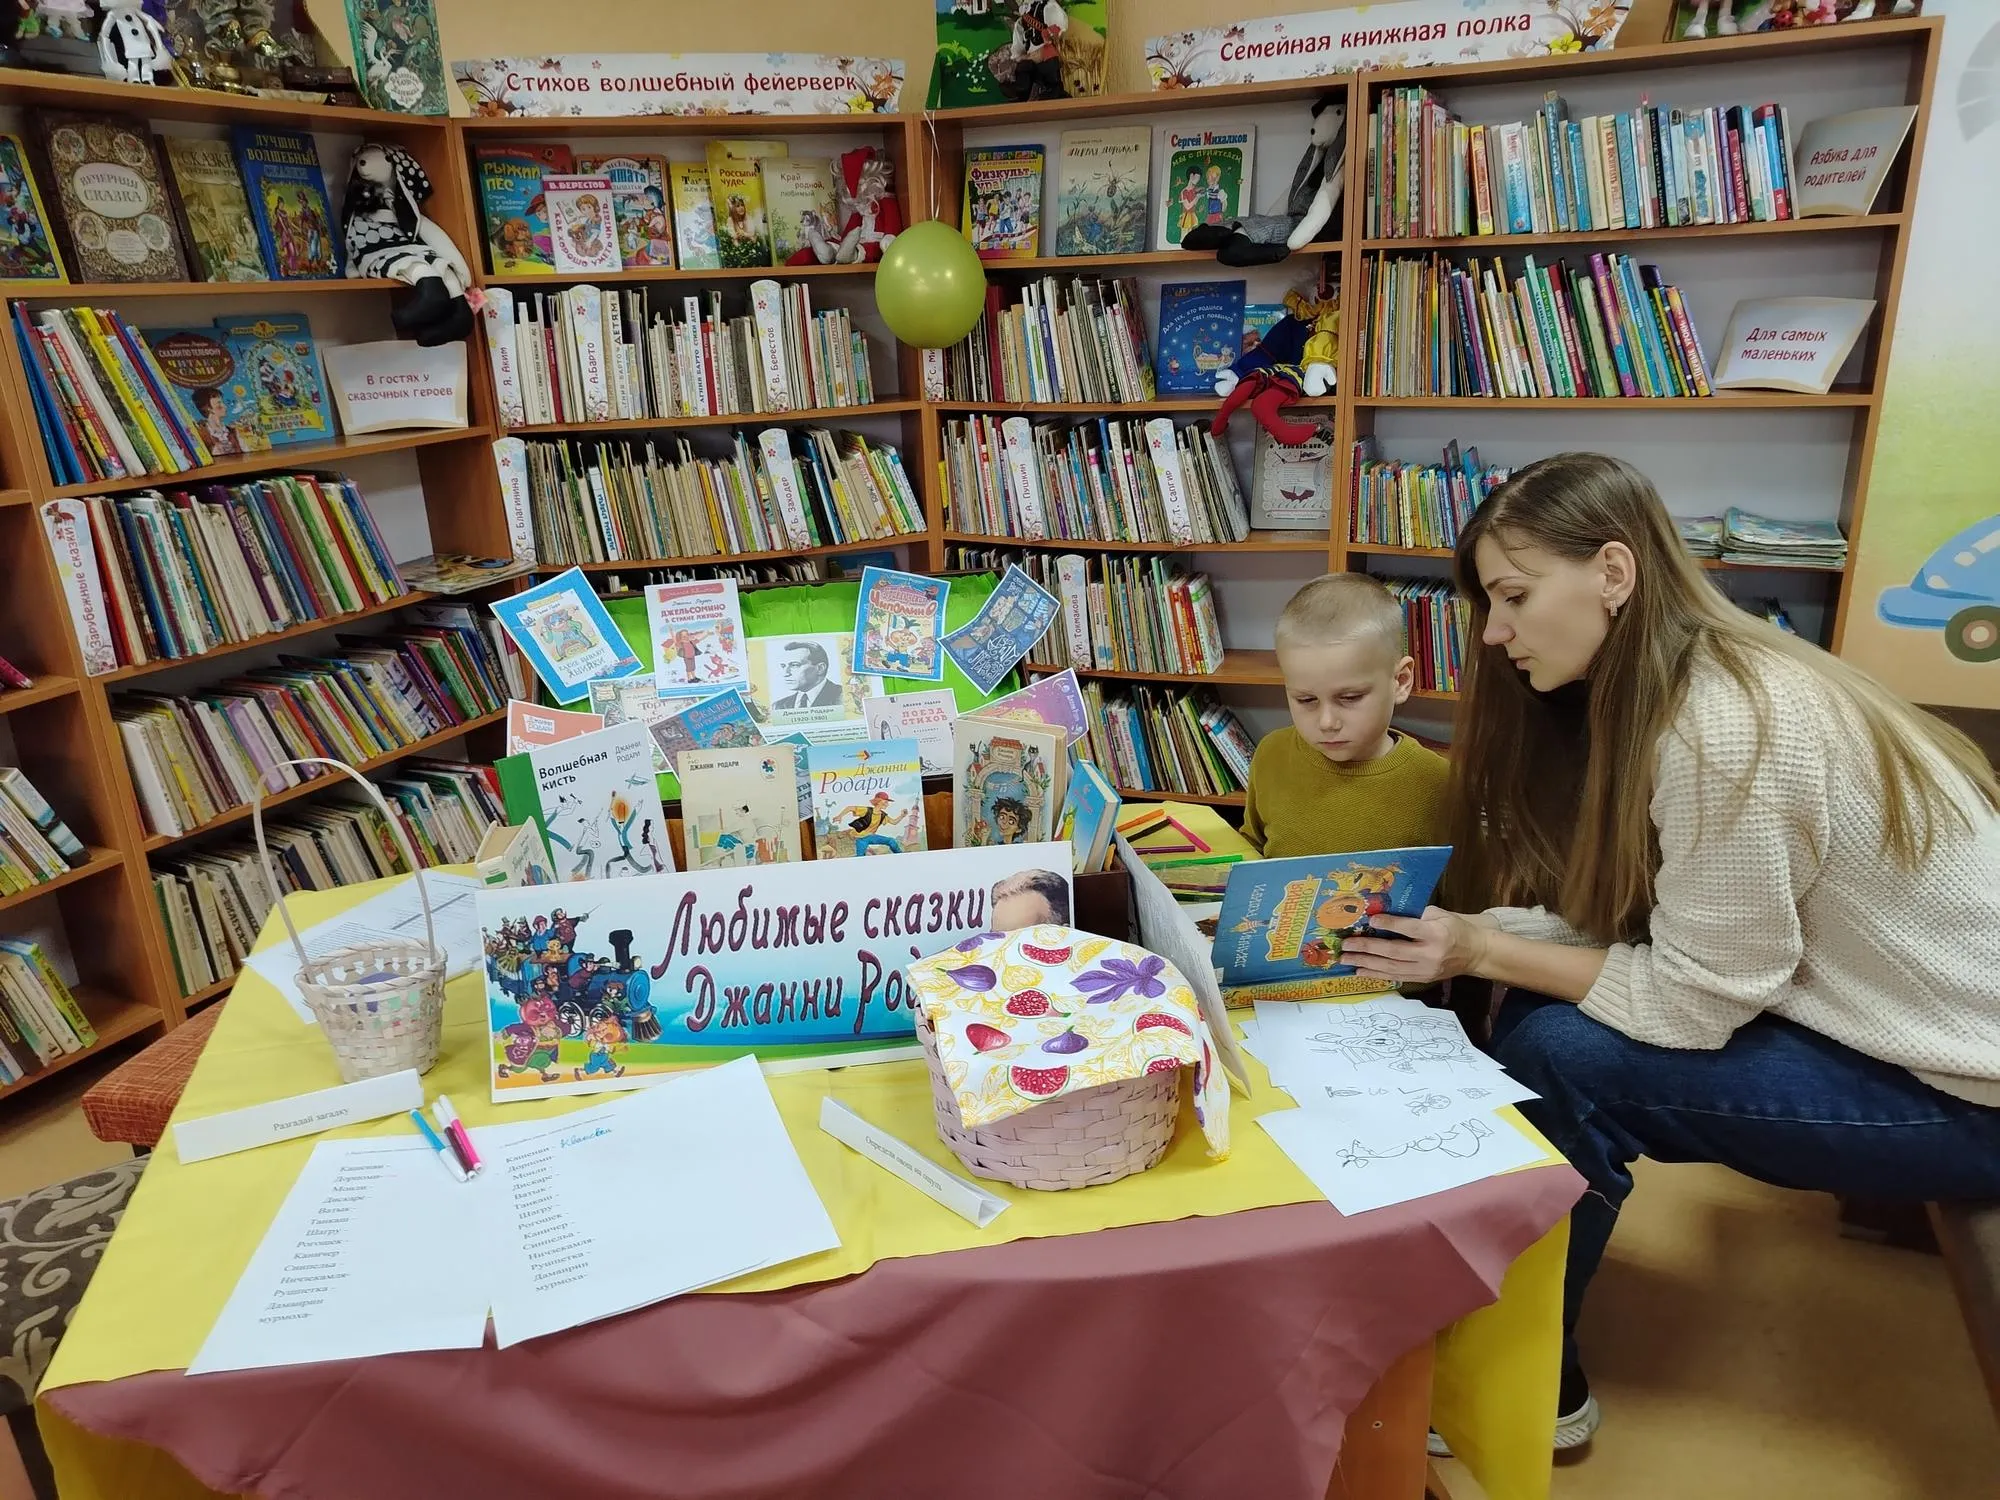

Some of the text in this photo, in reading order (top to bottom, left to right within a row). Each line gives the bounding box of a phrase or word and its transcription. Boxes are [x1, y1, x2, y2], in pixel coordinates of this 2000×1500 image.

[1220, 12, 1532, 62] Семейная книжная полка
[506, 73, 857, 94] Стихов волшебный фейерверк
[255, 134, 302, 149] ЛУЧШИЕ
[1171, 131, 1248, 149] Сергей Михалков
[247, 148, 319, 167] ВОЛШЕБНЫЕ
[1810, 144, 1878, 167] Азбука для
[483, 162, 541, 178] РЫЖИЙ
[1804, 166, 1867, 187] родителей
[83, 189, 143, 203] СКАЗКА
[609, 302, 621, 344] ДЕТЯМ
[1746, 326, 1829, 346] Для самых
[588, 341, 600, 384] А.Барто
[767, 326, 782, 384] В. Берестов
[1740, 344, 1816, 364] маленьких
[179, 366, 216, 377] САМИ
[500, 346, 512, 388] Я. Аким
[366, 373, 431, 386] В гостях у
[348, 387, 453, 402] сказочных героев
[1018, 463, 1034, 511] А. Пушкин
[1165, 470, 1178, 502] Сапгир
[510, 478, 529, 541] Е. Благинина
[781, 476, 800, 525] Б. Заходер
[65, 518, 102, 649] Зарубежные сказки
[661, 603, 726, 618] ДЖЕЛЬСОМИНО
[671, 615, 694, 623] СТРАНЕ
[1072, 593, 1082, 638] Токмакова
[902, 707, 945, 718] ПОЕЗД
[902, 715, 948, 725] СТИХОВ
[615, 741, 642, 755] ДЖАННИ
[617, 751, 641, 763] РОДАРИ
[539, 751, 609, 779] Волшебная
[689, 761, 739, 772] ДЖАННИ РОДАРИ
[854, 762, 908, 778] Джанни
[541, 775, 577, 791] кисть
[819, 770, 891, 796] Родари
[1234, 883, 1267, 968] ДЖАННИ РОДАРИ
[1269, 883, 1306, 958] ПРИКЛЮЧЕНИЯ
[1283, 887, 1314, 954] ЧИПОЛЛИНО
[651, 884, 986, 980] Любимые сказки
[686, 964, 843, 1033] Джанни
[272, 1108, 350, 1132] Разгадай загадку
[517, 1213, 563, 1231] Рогошек
[518, 1205, 553, 1220] Шагру
